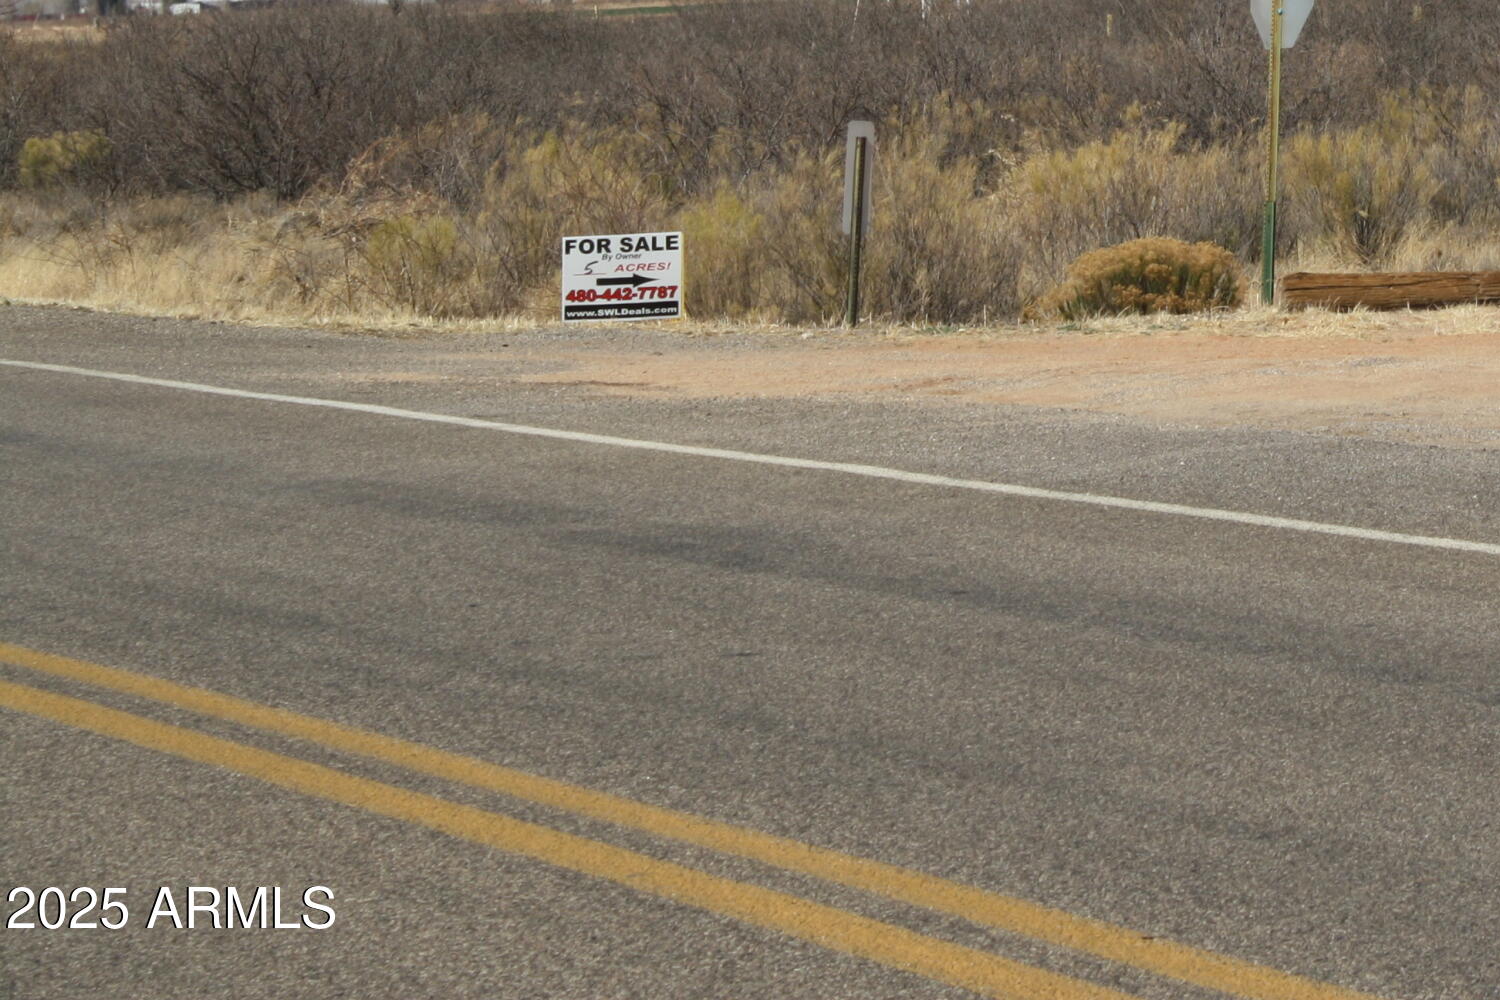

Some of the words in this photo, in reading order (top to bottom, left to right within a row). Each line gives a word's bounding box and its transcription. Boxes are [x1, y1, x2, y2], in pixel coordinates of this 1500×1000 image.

[565, 239, 612, 255] FOR
[620, 235, 679, 252] SALE
[601, 253, 613, 261] By
[614, 262, 671, 273] ACRES!
[565, 285, 678, 302] 480-442-7787
[566, 307, 677, 317] www.SWLDeals.com
